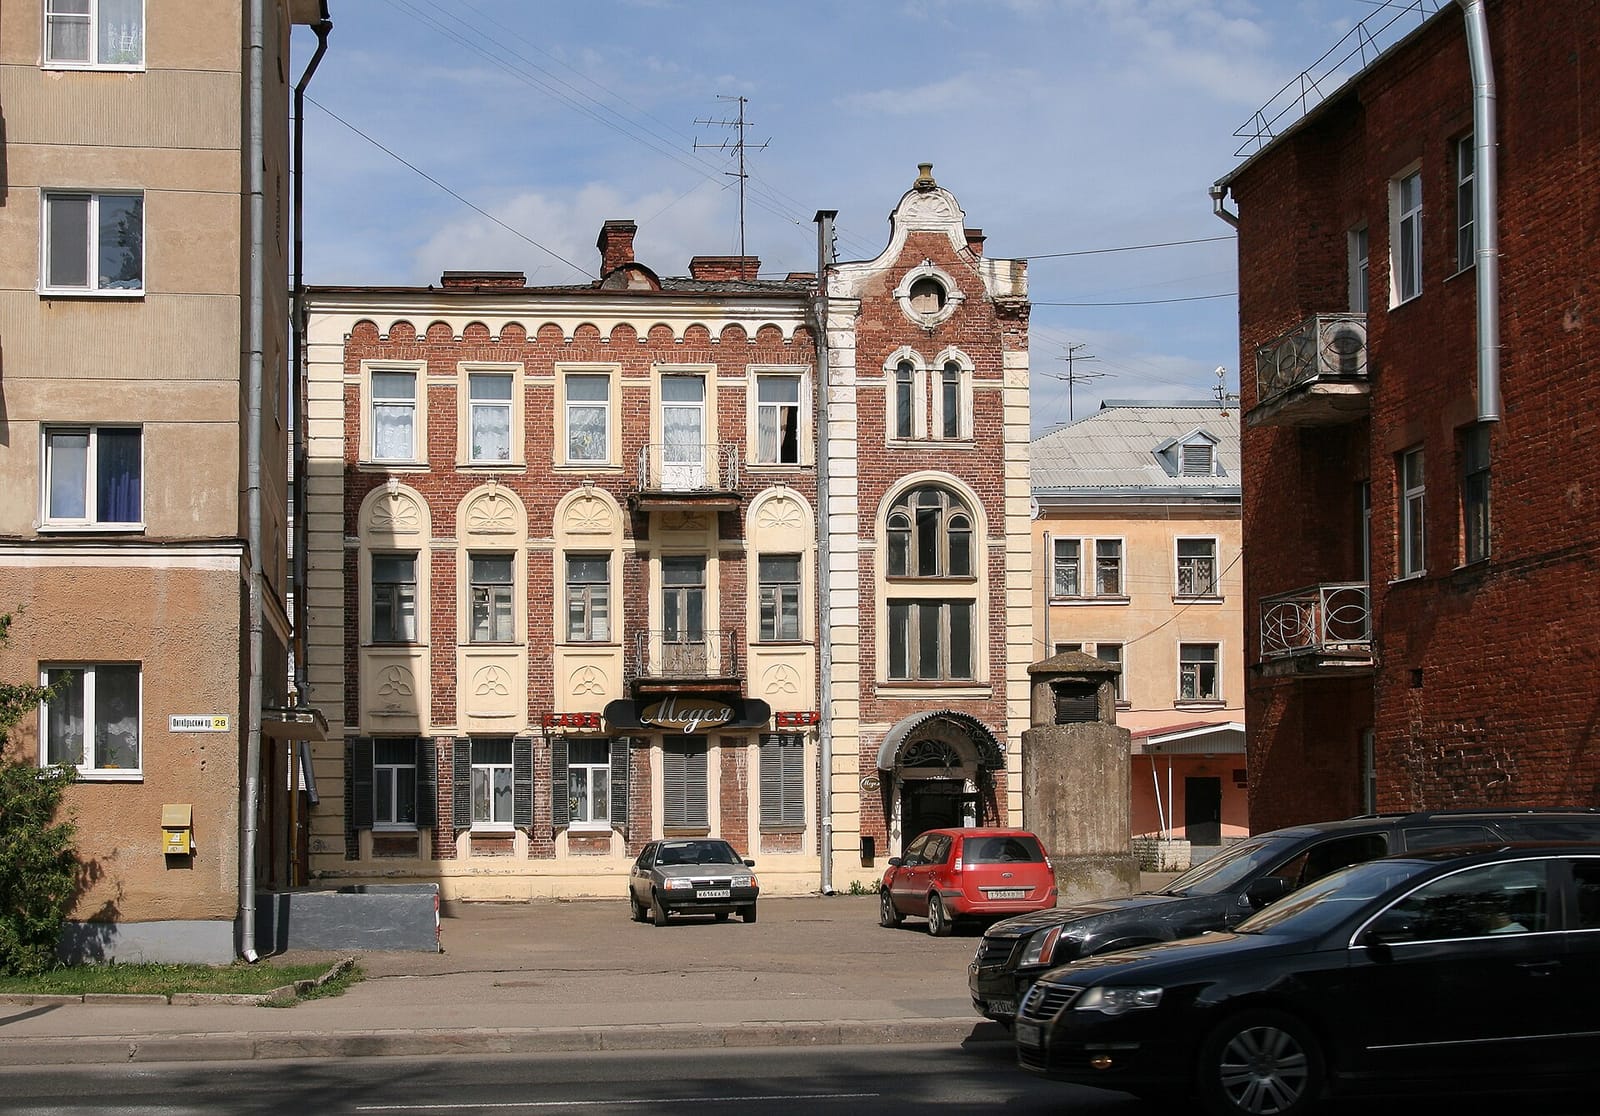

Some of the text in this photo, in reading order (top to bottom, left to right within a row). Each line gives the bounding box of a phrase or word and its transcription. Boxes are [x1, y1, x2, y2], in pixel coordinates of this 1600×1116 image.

[214, 719, 226, 727] 28
[543, 712, 601, 728] КАФЕ
[640, 696, 731, 734] Медея
[778, 711, 820, 727] БАР
